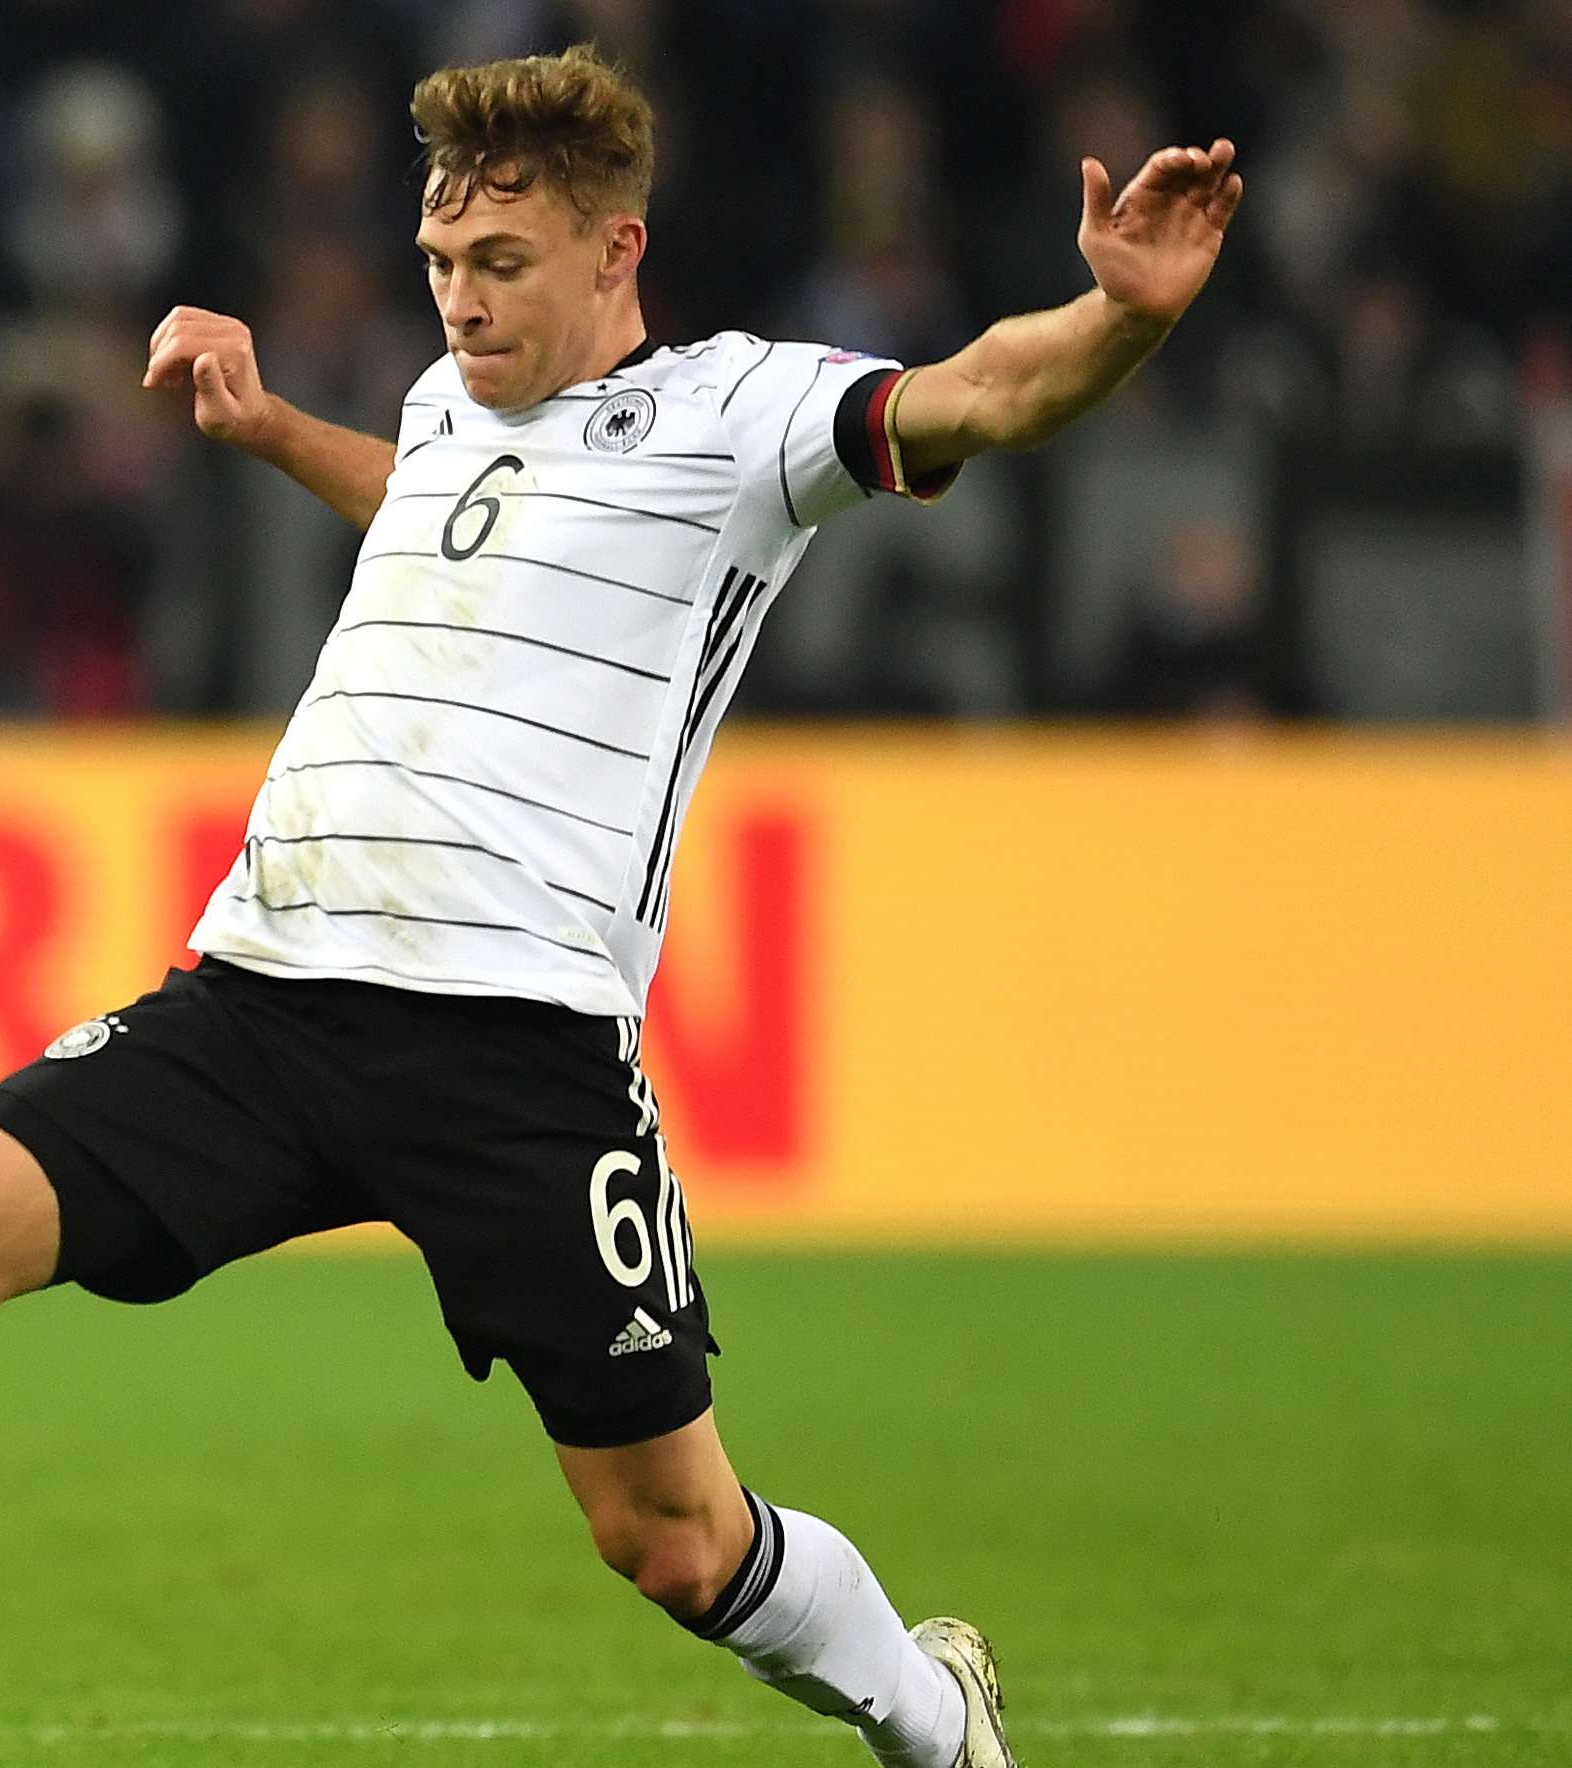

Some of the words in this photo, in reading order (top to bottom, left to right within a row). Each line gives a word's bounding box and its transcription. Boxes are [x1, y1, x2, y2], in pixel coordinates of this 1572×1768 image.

[441, 454, 525, 561] 6
[589, 1150, 652, 1288] 6
[608, 1328, 673, 1357] adidas
